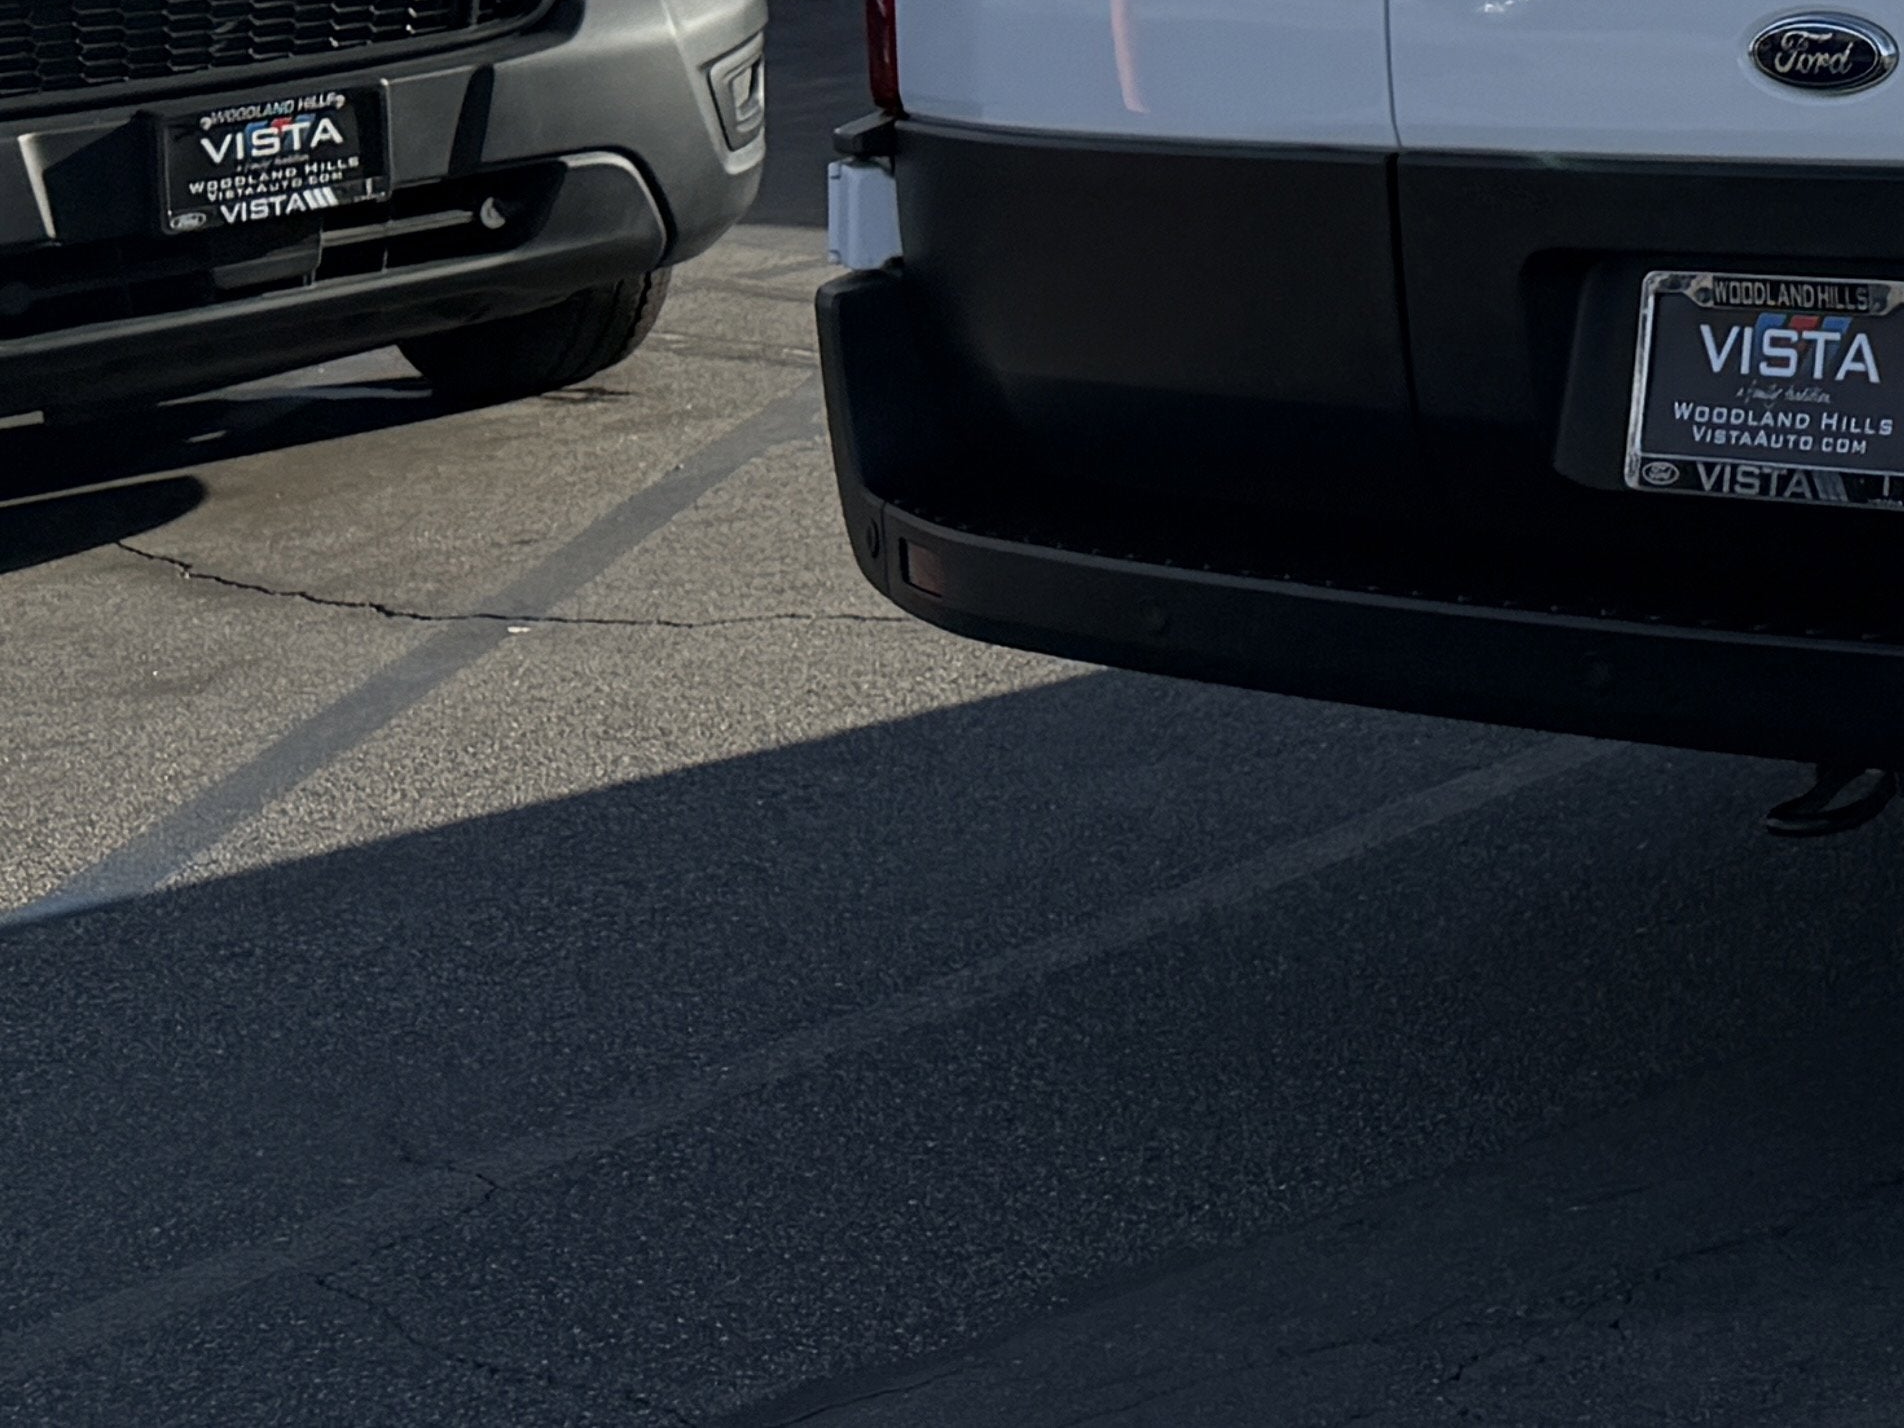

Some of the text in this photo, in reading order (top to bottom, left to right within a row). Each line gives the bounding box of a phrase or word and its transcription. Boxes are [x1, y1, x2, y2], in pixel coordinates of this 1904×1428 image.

[1774, 30, 1854, 74] Ford
[200, 117, 344, 164] VISTA
[189, 167, 297, 194] WOODLAND
[305, 156, 360, 174] HILLS
[220, 193, 306, 224] VISTA
[1713, 275, 1869, 311] WOODLAND HILLS
[1700, 324, 1881, 383] VISTA
[1696, 461, 1815, 500] VISTA
